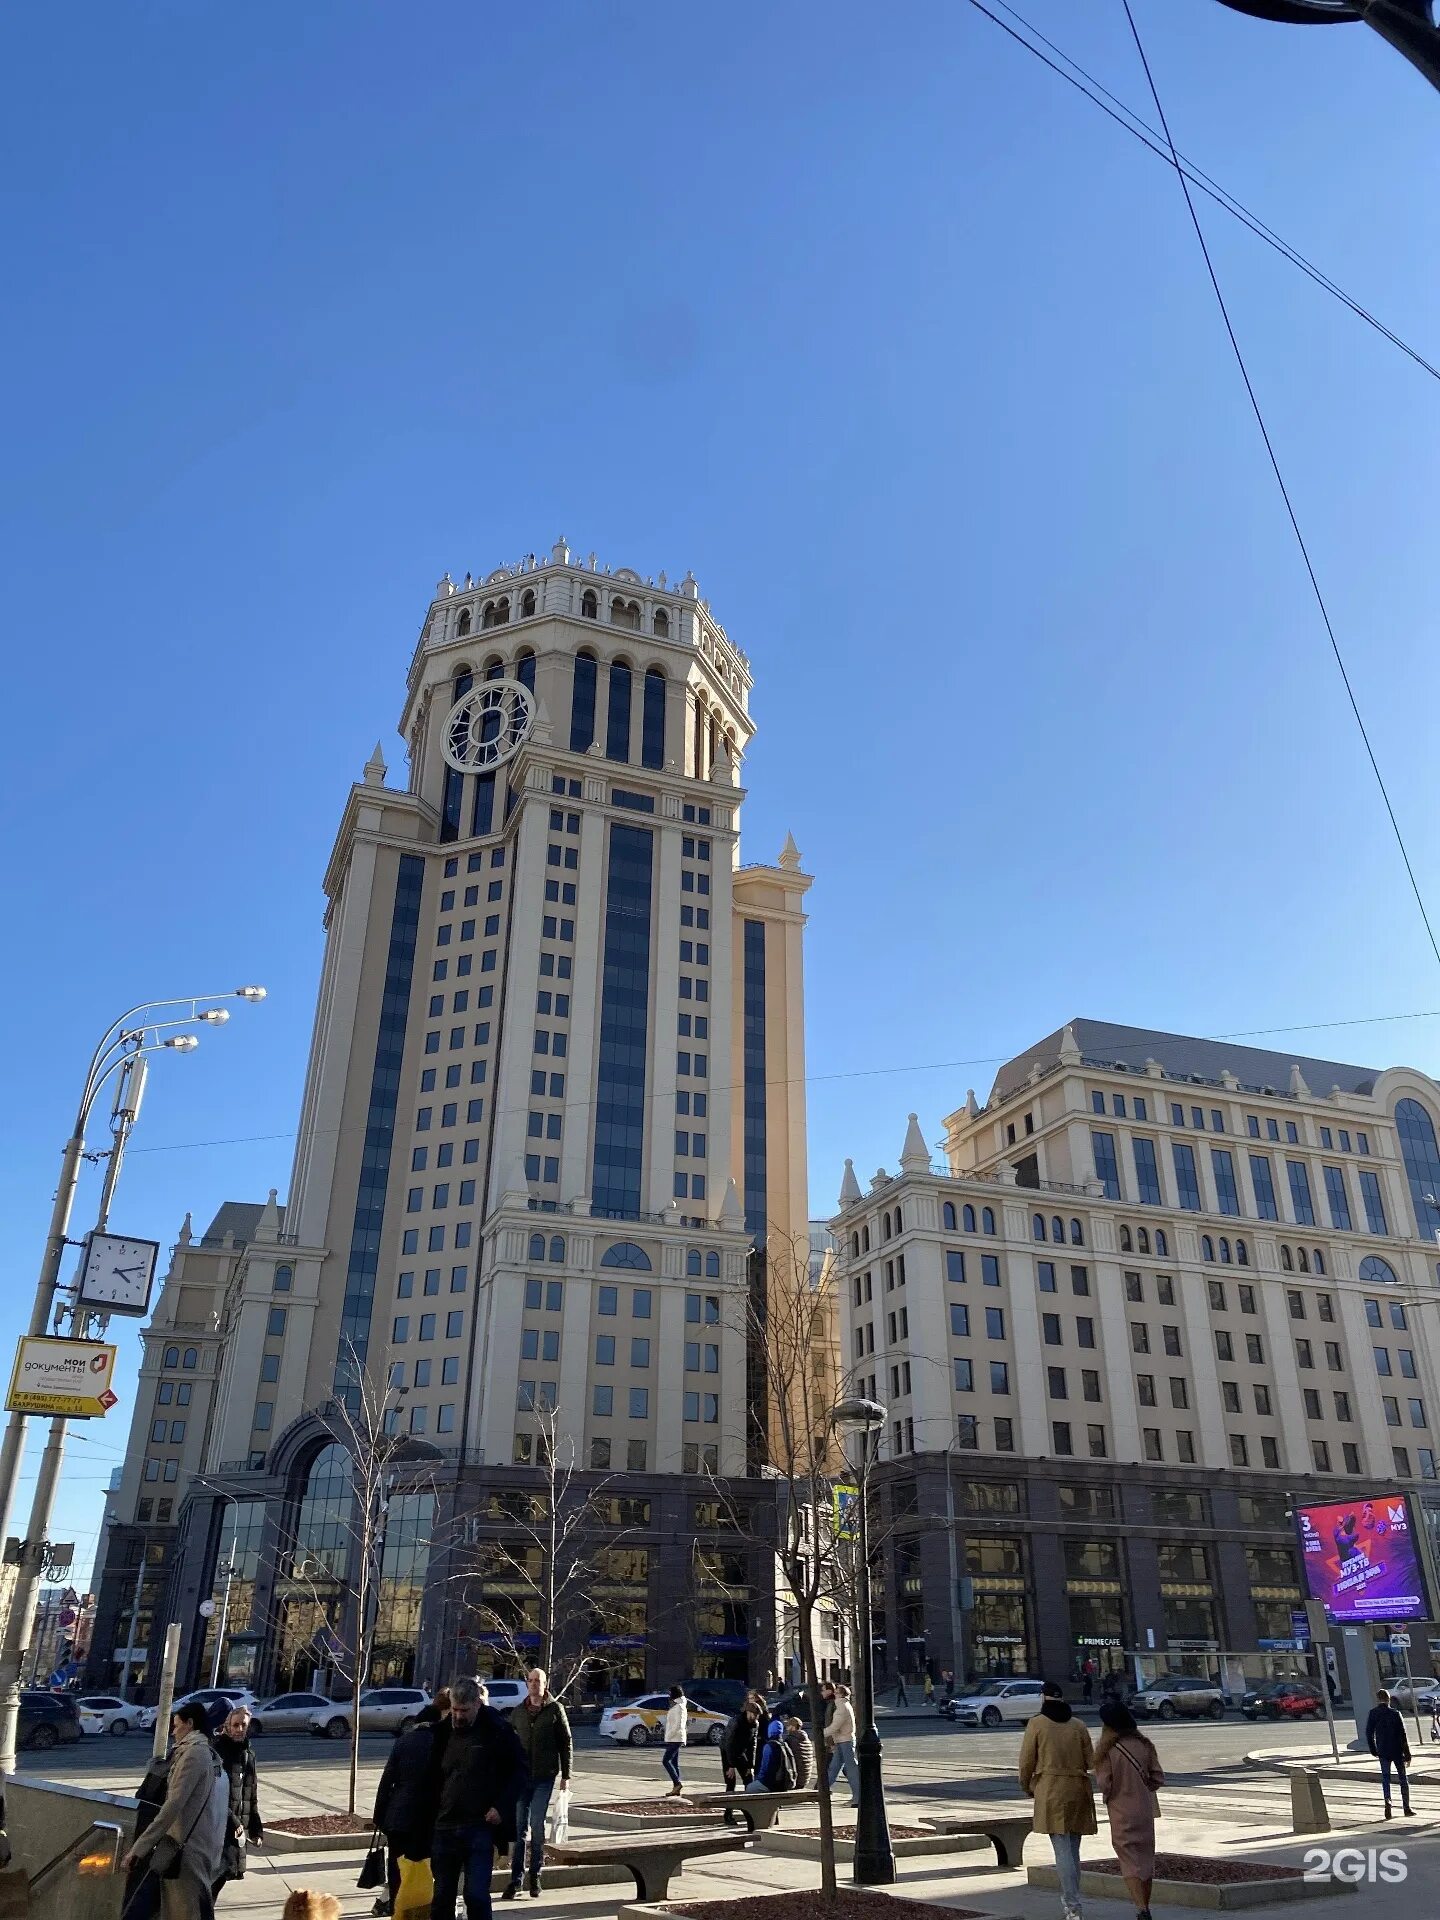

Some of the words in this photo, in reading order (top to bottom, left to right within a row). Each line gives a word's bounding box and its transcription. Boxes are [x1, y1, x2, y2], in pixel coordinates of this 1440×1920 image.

[12, 1401, 55, 1410] БАХРУШИНА
[1301, 1516, 1311, 1532] 3
[1390, 1522, 1407, 1531] МУЗ
[1340, 1557, 1370, 1579] МУЗ-ТВ
